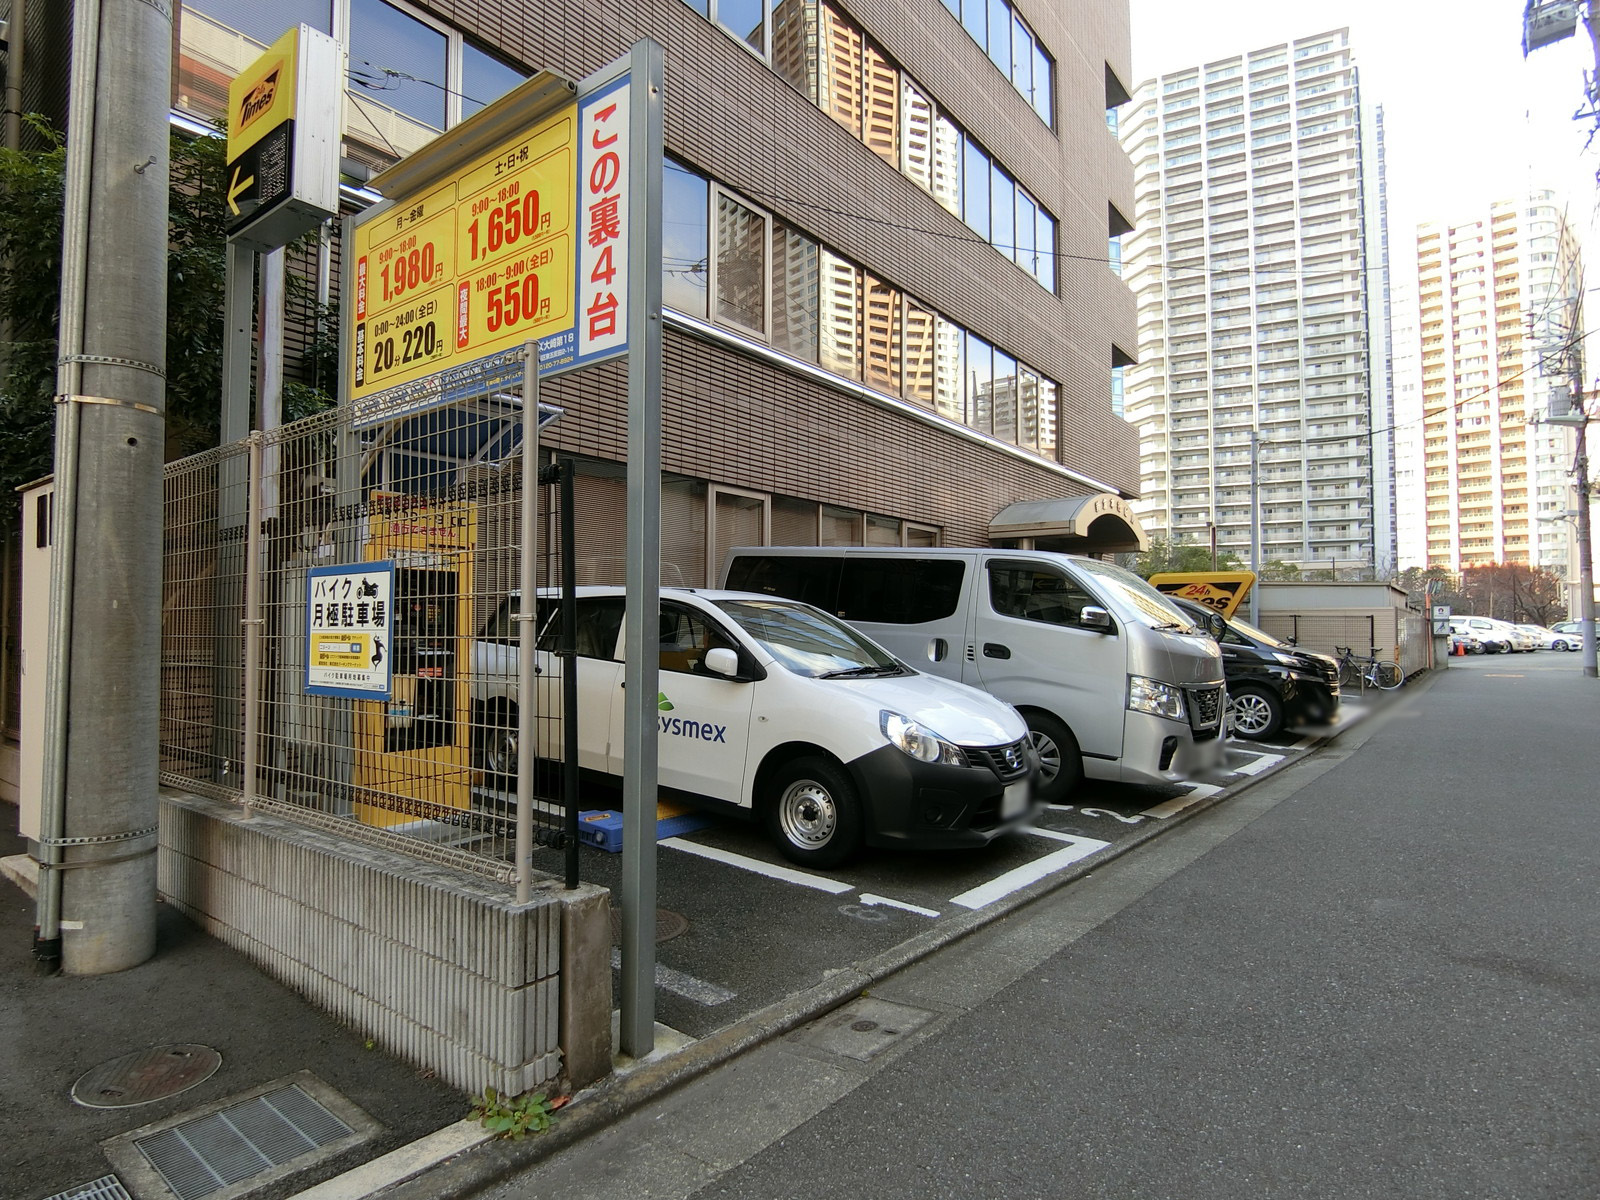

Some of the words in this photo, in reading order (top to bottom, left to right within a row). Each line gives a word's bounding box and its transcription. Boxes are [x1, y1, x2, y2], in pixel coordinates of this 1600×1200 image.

[240, 87, 275, 128] Times
[587, 102, 621, 341] この裏4台
[314, 577, 352, 600] バイク
[1185, 585, 1211, 595] 24h
[313, 600, 386, 627] 月極駐車場
[657, 715, 727, 743] ysmex
